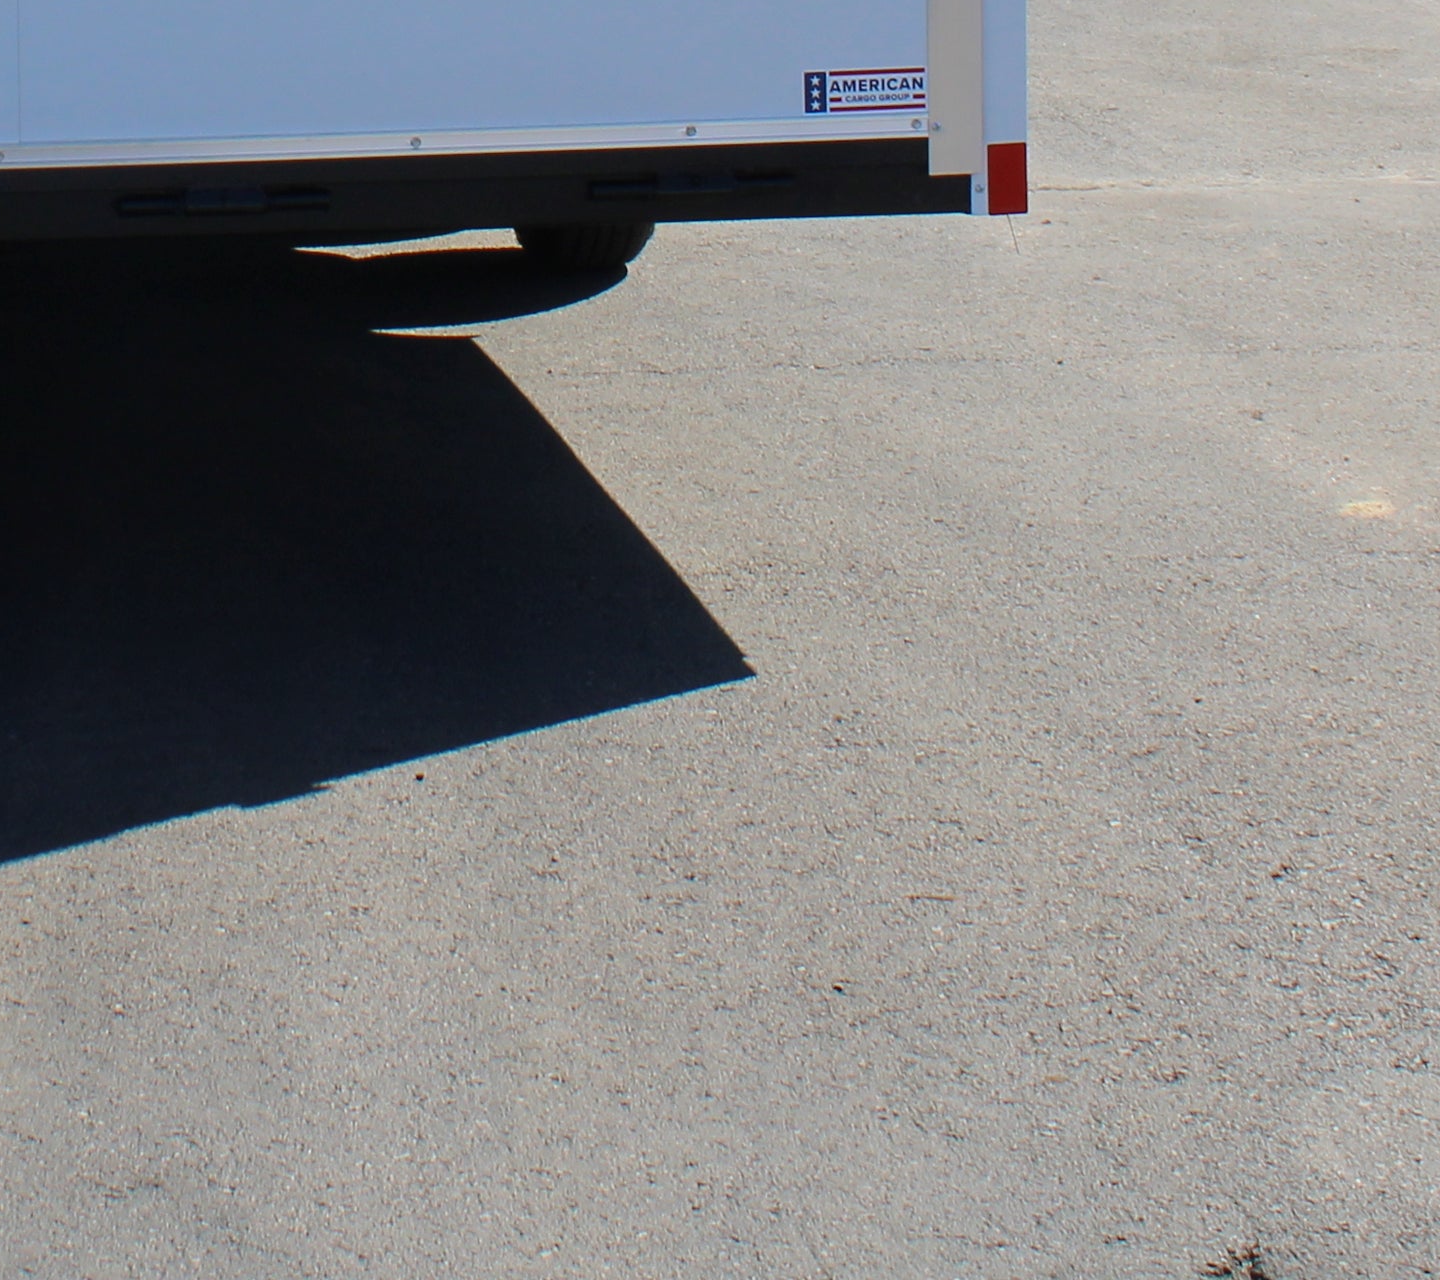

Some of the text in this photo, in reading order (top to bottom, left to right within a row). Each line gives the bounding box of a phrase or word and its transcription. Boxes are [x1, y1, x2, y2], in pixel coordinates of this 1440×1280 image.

[829, 77, 924, 93] AMERICAN
[845, 93, 910, 103] CARGO GROUP
